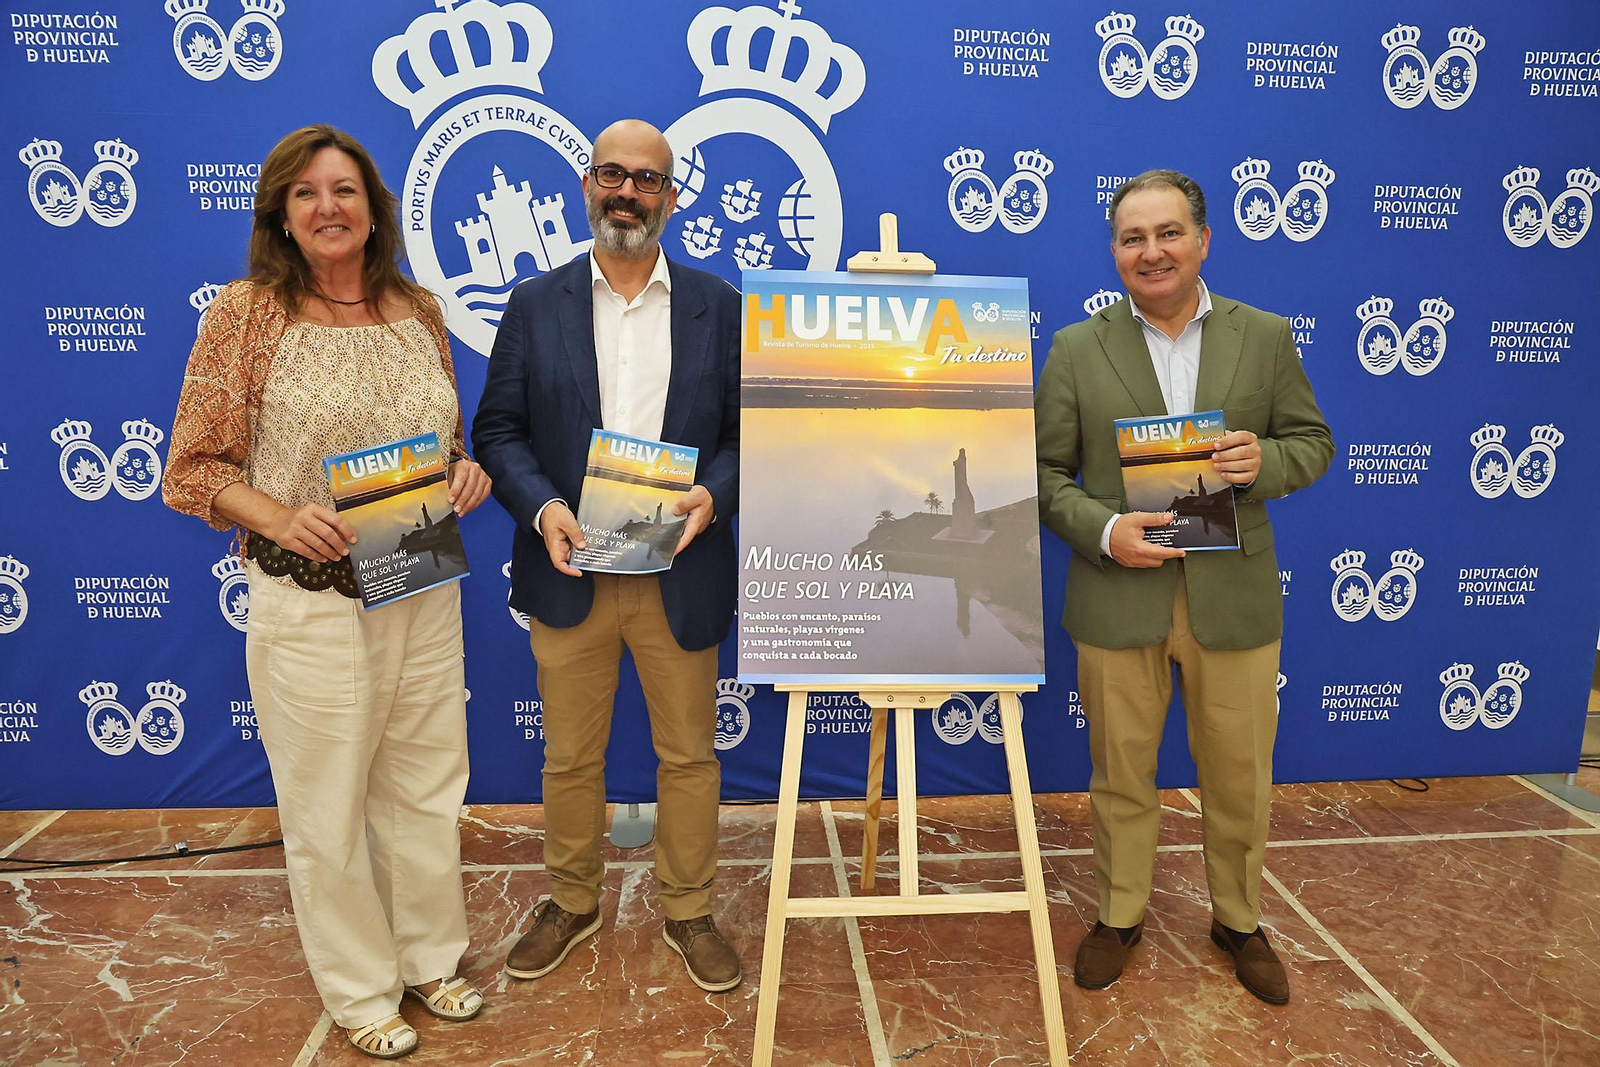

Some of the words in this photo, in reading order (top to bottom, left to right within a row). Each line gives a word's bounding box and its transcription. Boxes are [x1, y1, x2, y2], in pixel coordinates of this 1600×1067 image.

[10, 10, 118, 29] DIPUTACIÓN
[13, 30, 119, 46] PROVINCIAL
[953, 28, 1051, 46] DIPUTACIÓN
[42, 48, 110, 64] HUELVA
[954, 44, 1050, 62] PROVINCIAL
[1246, 41, 1339, 59] DIPUTACIÓN
[1523, 49, 1600, 65] DIPUTACIÓ
[978, 62, 1039, 78] HUELVA
[1246, 57, 1337, 75] PROVINCIAL
[1523, 67, 1600, 81] PROVINCIA
[1268, 74, 1326, 90] HUELVA
[1543, 83, 1599, 97] HUELVA
[186, 163, 262, 178] DIPUTACI
[411, 168, 432, 232] PORTVS
[423, 124, 463, 168] MARIS
[462, 110, 481, 129] ET
[484, 106, 547, 131] TERRAE
[548, 123, 592, 173] CVSTO
[1374, 183, 1462, 200] DIPUTACIÓN
[1373, 200, 1459, 215] PROVINCIAL
[1394, 216, 1449, 230] HUELVA
[44, 303, 146, 321] DIPUTACIÓN
[47, 322, 147, 336] PROVINCIAL
[746, 293, 969, 356] HUELVA
[1490, 319, 1575, 335] DIPUTACIÓN
[74, 338, 138, 352] HUELVA
[763, 340, 786, 349] Revista
[795, 341, 820, 349] Turismo
[820, 341, 829, 349] de
[829, 342, 851, 350] Huelva
[1489, 335, 1571, 349] PROVINCIAL
[940, 345, 964, 365] Tu
[966, 345, 1028, 364] destino
[1508, 350, 1561, 363] HUELVA
[1118, 421, 1198, 448] HUELVA
[594, 435, 672, 469] HUELVA
[1348, 441, 1432, 457] DIPUTACIÓN
[329, 446, 418, 490] HUELVA
[1347, 458, 1429, 471] PROVINCIAL
[1367, 472, 1419, 486] HUELVA
[580, 523, 610, 537] MUCHO
[611, 531, 628, 540] MÁS
[594, 538, 607, 546] SOL
[615, 541, 636, 550] PLAYA
[359, 555, 391, 571] MUCHO
[744, 545, 834, 571] MUCHO
[839, 550, 884, 571] MÁS
[361, 569, 378, 582] QUE
[379, 565, 393, 576] SOL
[393, 562, 399, 571] Y
[400, 556, 420, 569] PLAYA
[1458, 564, 1539, 580] DIPUTACIÓN
[74, 573, 170, 590] DIPUTACIÓN
[1457, 581, 1536, 593] PROVINCIAL
[76, 591, 171, 604] PROVINCIAL
[744, 580, 788, 603] QUE
[794, 581, 831, 600] SOL
[839, 581, 852, 600] Y
[857, 582, 915, 601] PLAYA
[1476, 594, 1526, 606] HUELVA
[102, 606, 162, 619] HUELVA
[743, 611, 780, 621] Pueblos
[781, 613, 798, 621] con
[800, 612, 840, 623] encanto,
[842, 612, 881, 624] paraísos
[743, 625, 791, 636] naturales,
[793, 625, 823, 636] playas
[825, 625, 865, 636] vírgenes
[742, 639, 749, 648] y
[751, 639, 770, 647] una
[771, 637, 832, 648] gastronomía
[833, 639, 852, 649] que
[743, 650, 789, 661] conquista
[791, 652, 798, 660] a
[799, 650, 822, 660] cada
[823, 650, 858, 661] bocado
[1322, 681, 1403, 697] DIPUTACIÓN
[808, 694, 864, 707] IPUTAC
[1321, 697, 1400, 709] PROVINCIAL
[806, 709, 873, 721] ROVINCI
[1340, 710, 1390, 722] HUELVA
